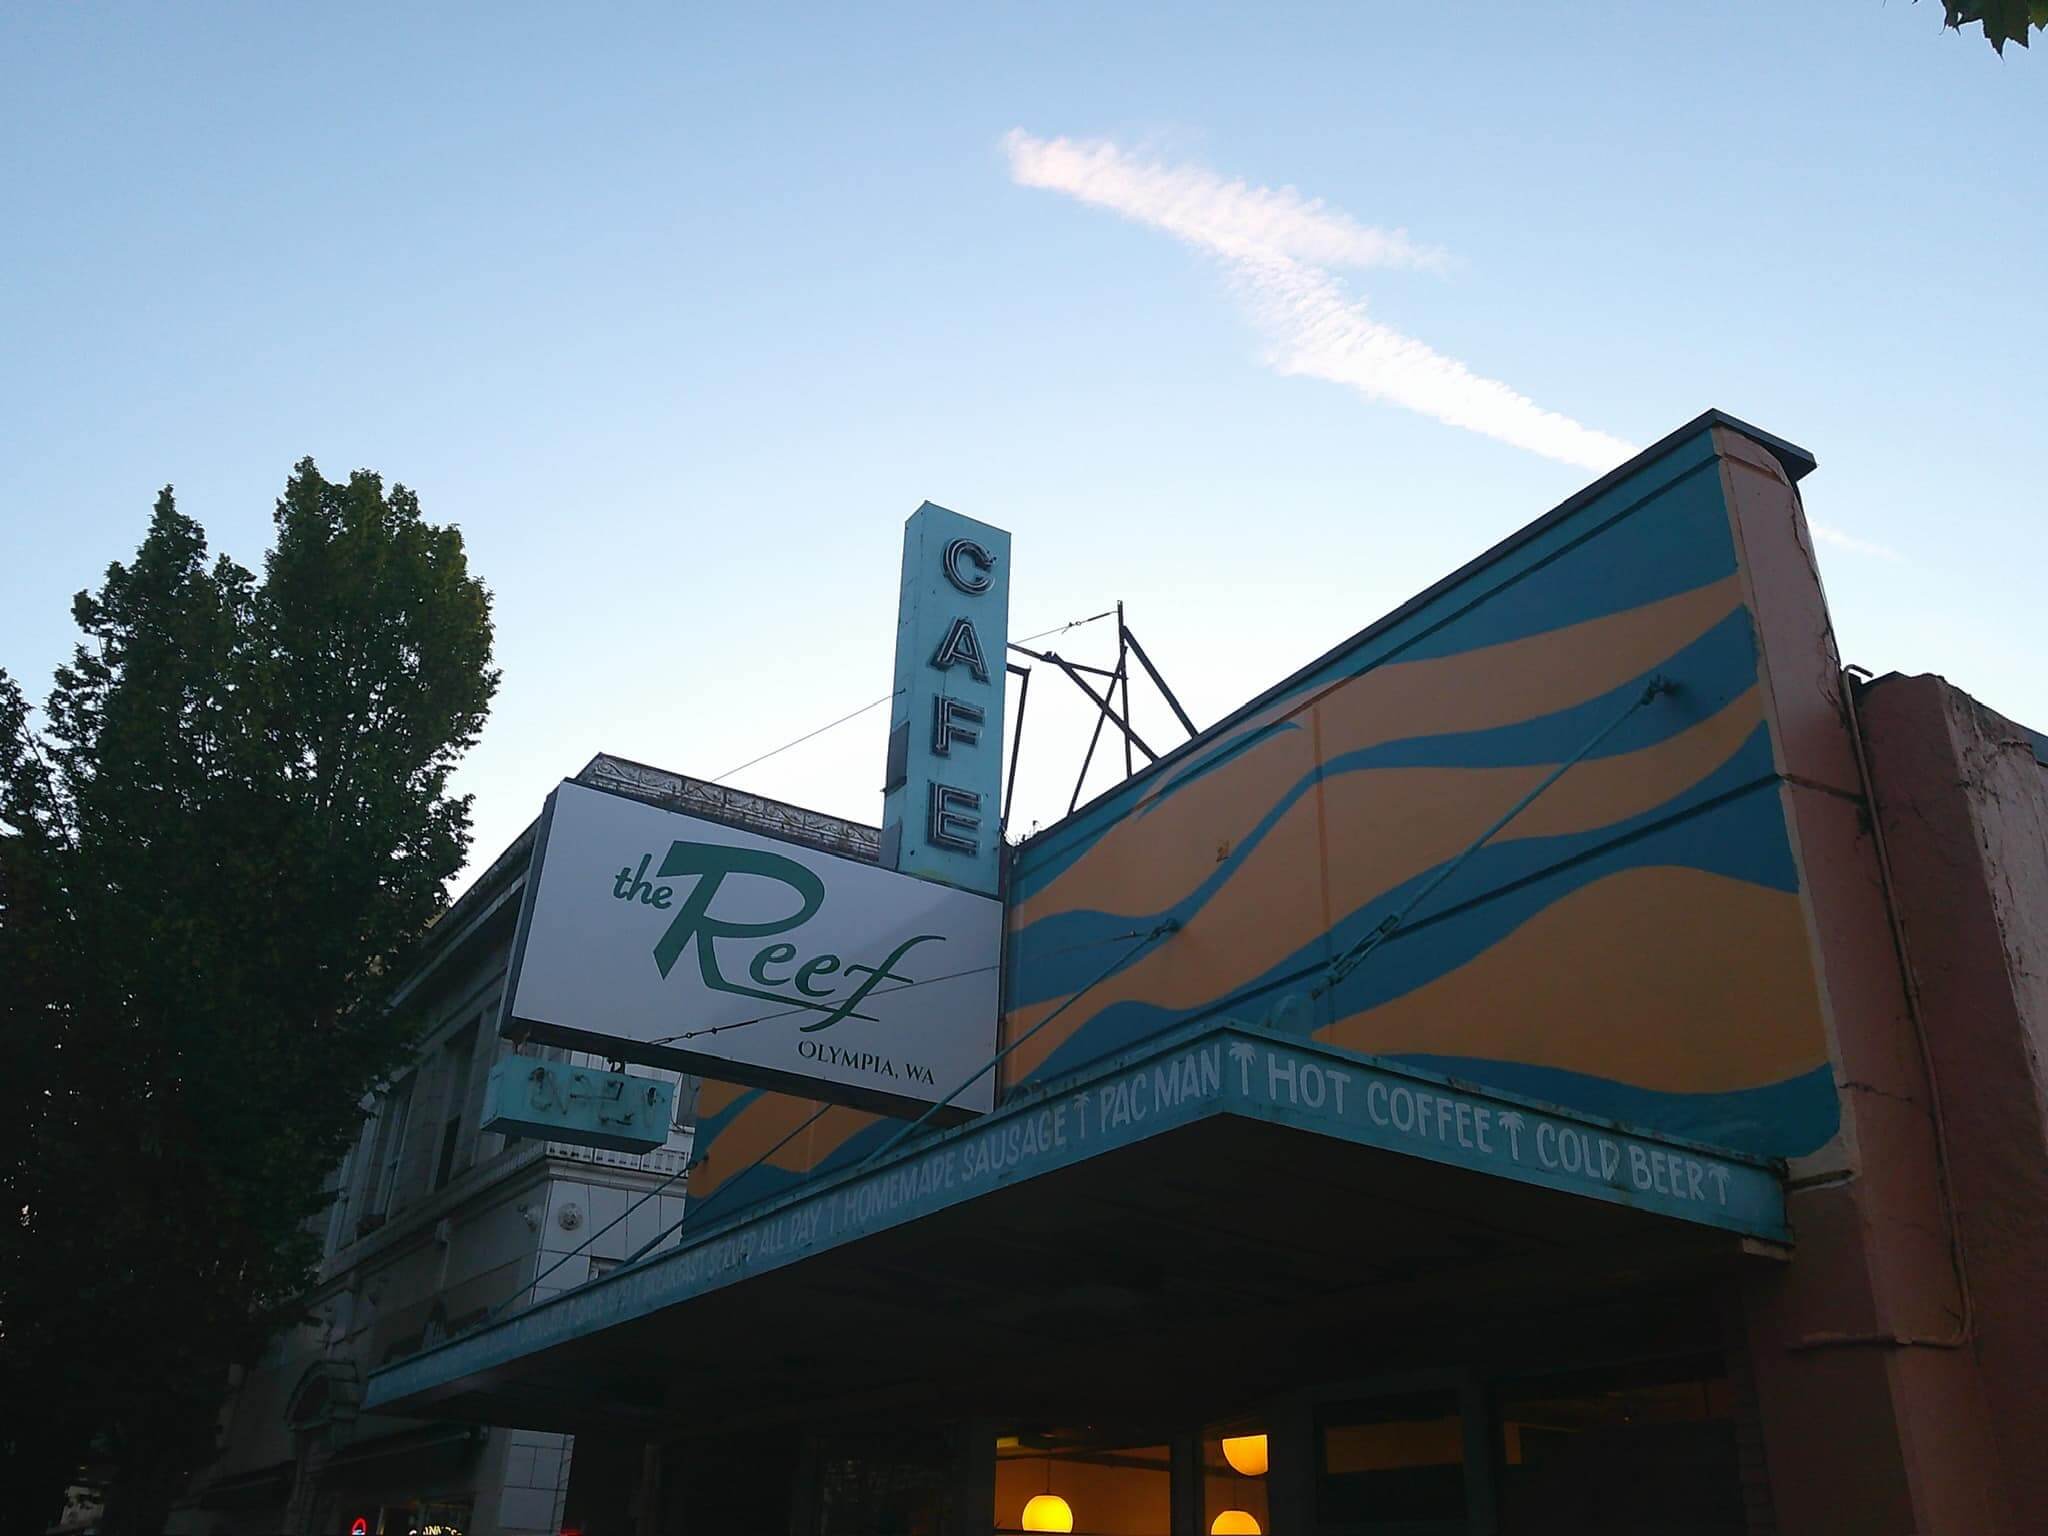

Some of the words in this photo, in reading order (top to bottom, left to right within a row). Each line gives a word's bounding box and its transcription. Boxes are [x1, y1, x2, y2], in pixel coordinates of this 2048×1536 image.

[927, 537, 996, 856] CAFE
[613, 853, 674, 909] the
[653, 840, 946, 1031] Reef
[758, 1219, 785, 1257] ALL
[790, 1202, 823, 1245] DAY
[843, 1152, 955, 1227] HOMEMADE
[961, 1104, 1067, 1182] SAUSAGE
[1099, 1072, 1147, 1133] PAC
[1154, 1043, 1221, 1113] MAN
[798, 1040, 898, 1079] OLYMPIA,
[905, 1063, 935, 1085] WA
[1267, 1053, 1351, 1115] HOT
[1367, 1081, 1494, 1154] COFFEE
[1536, 1123, 1620, 1182] COLD
[1628, 1145, 1705, 1202] BEER
